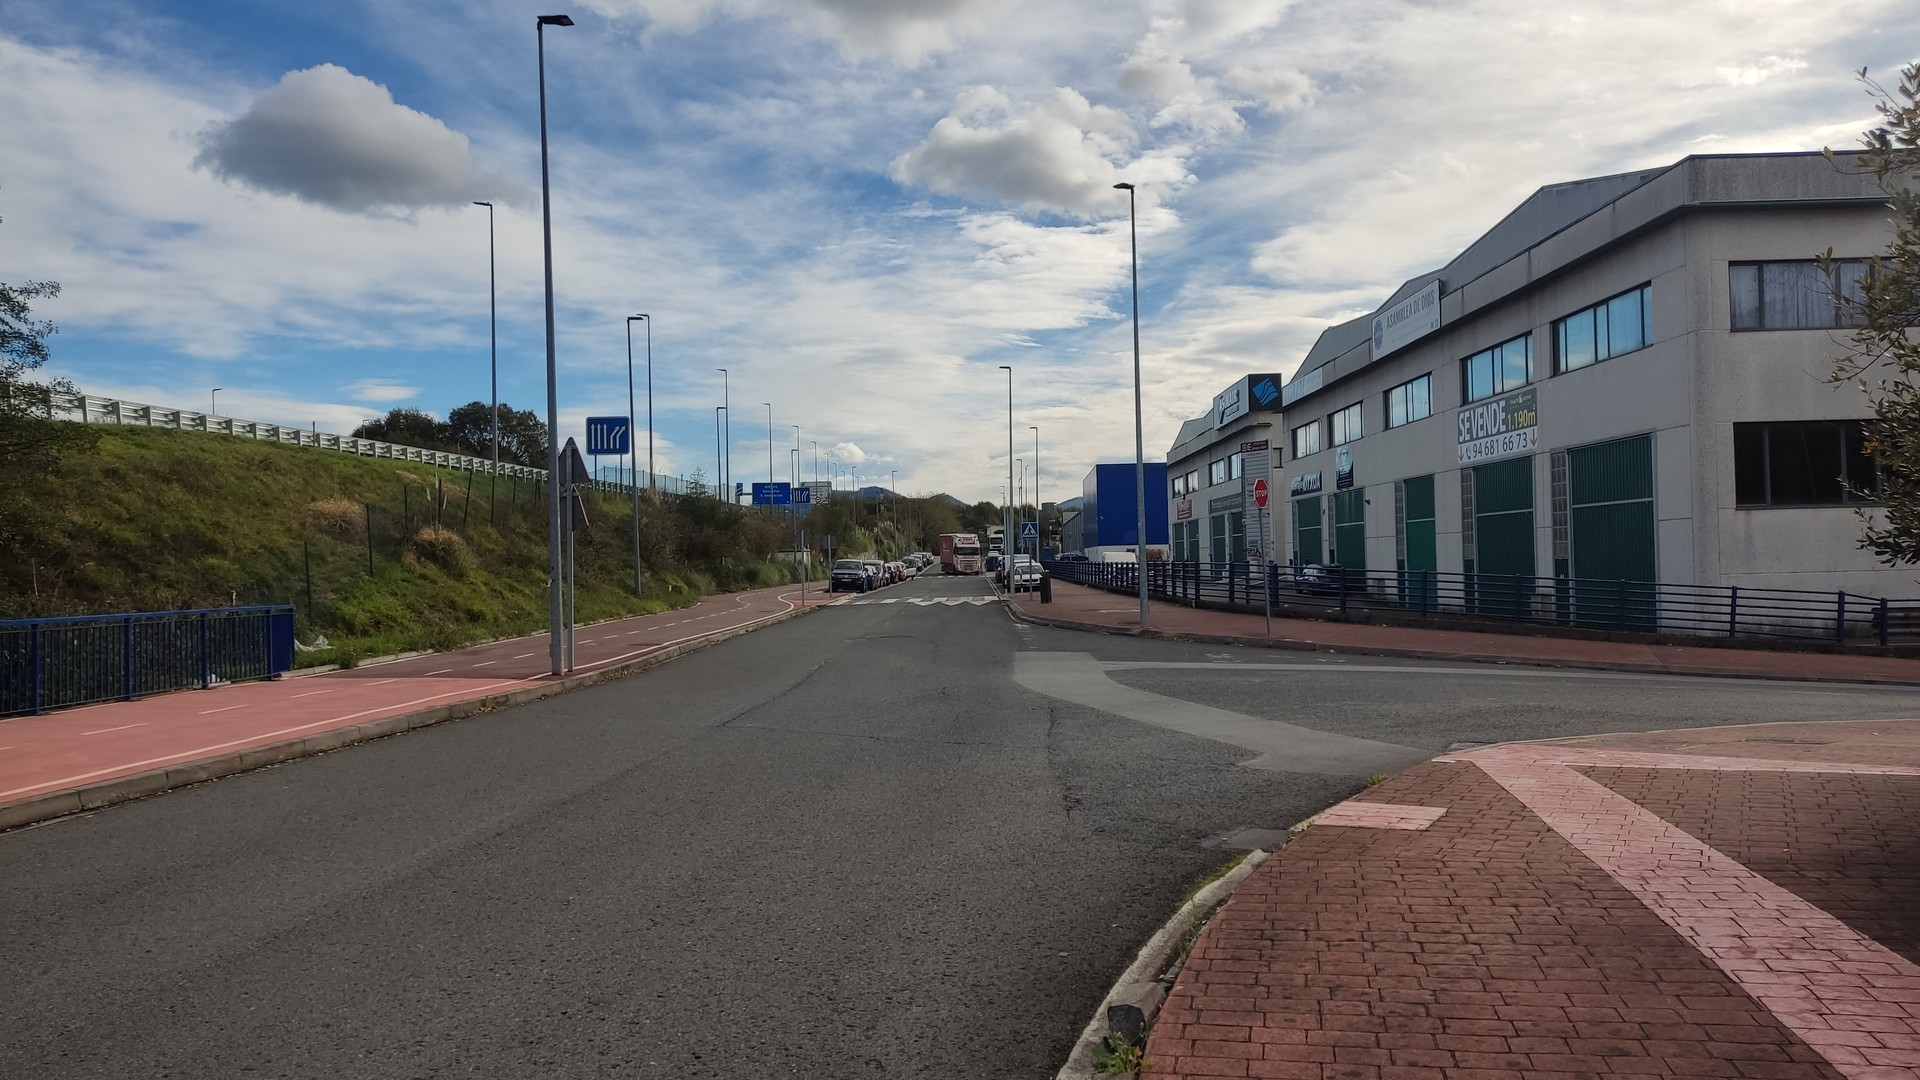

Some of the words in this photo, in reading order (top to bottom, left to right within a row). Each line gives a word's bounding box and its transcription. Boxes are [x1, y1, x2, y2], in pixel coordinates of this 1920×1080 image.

[1386, 303, 1414, 330] ASAMBLEA
[1413, 299, 1420, 314] DE
[1421, 289, 1435, 310] DIOS
[1256, 489, 1267, 498] STOP
